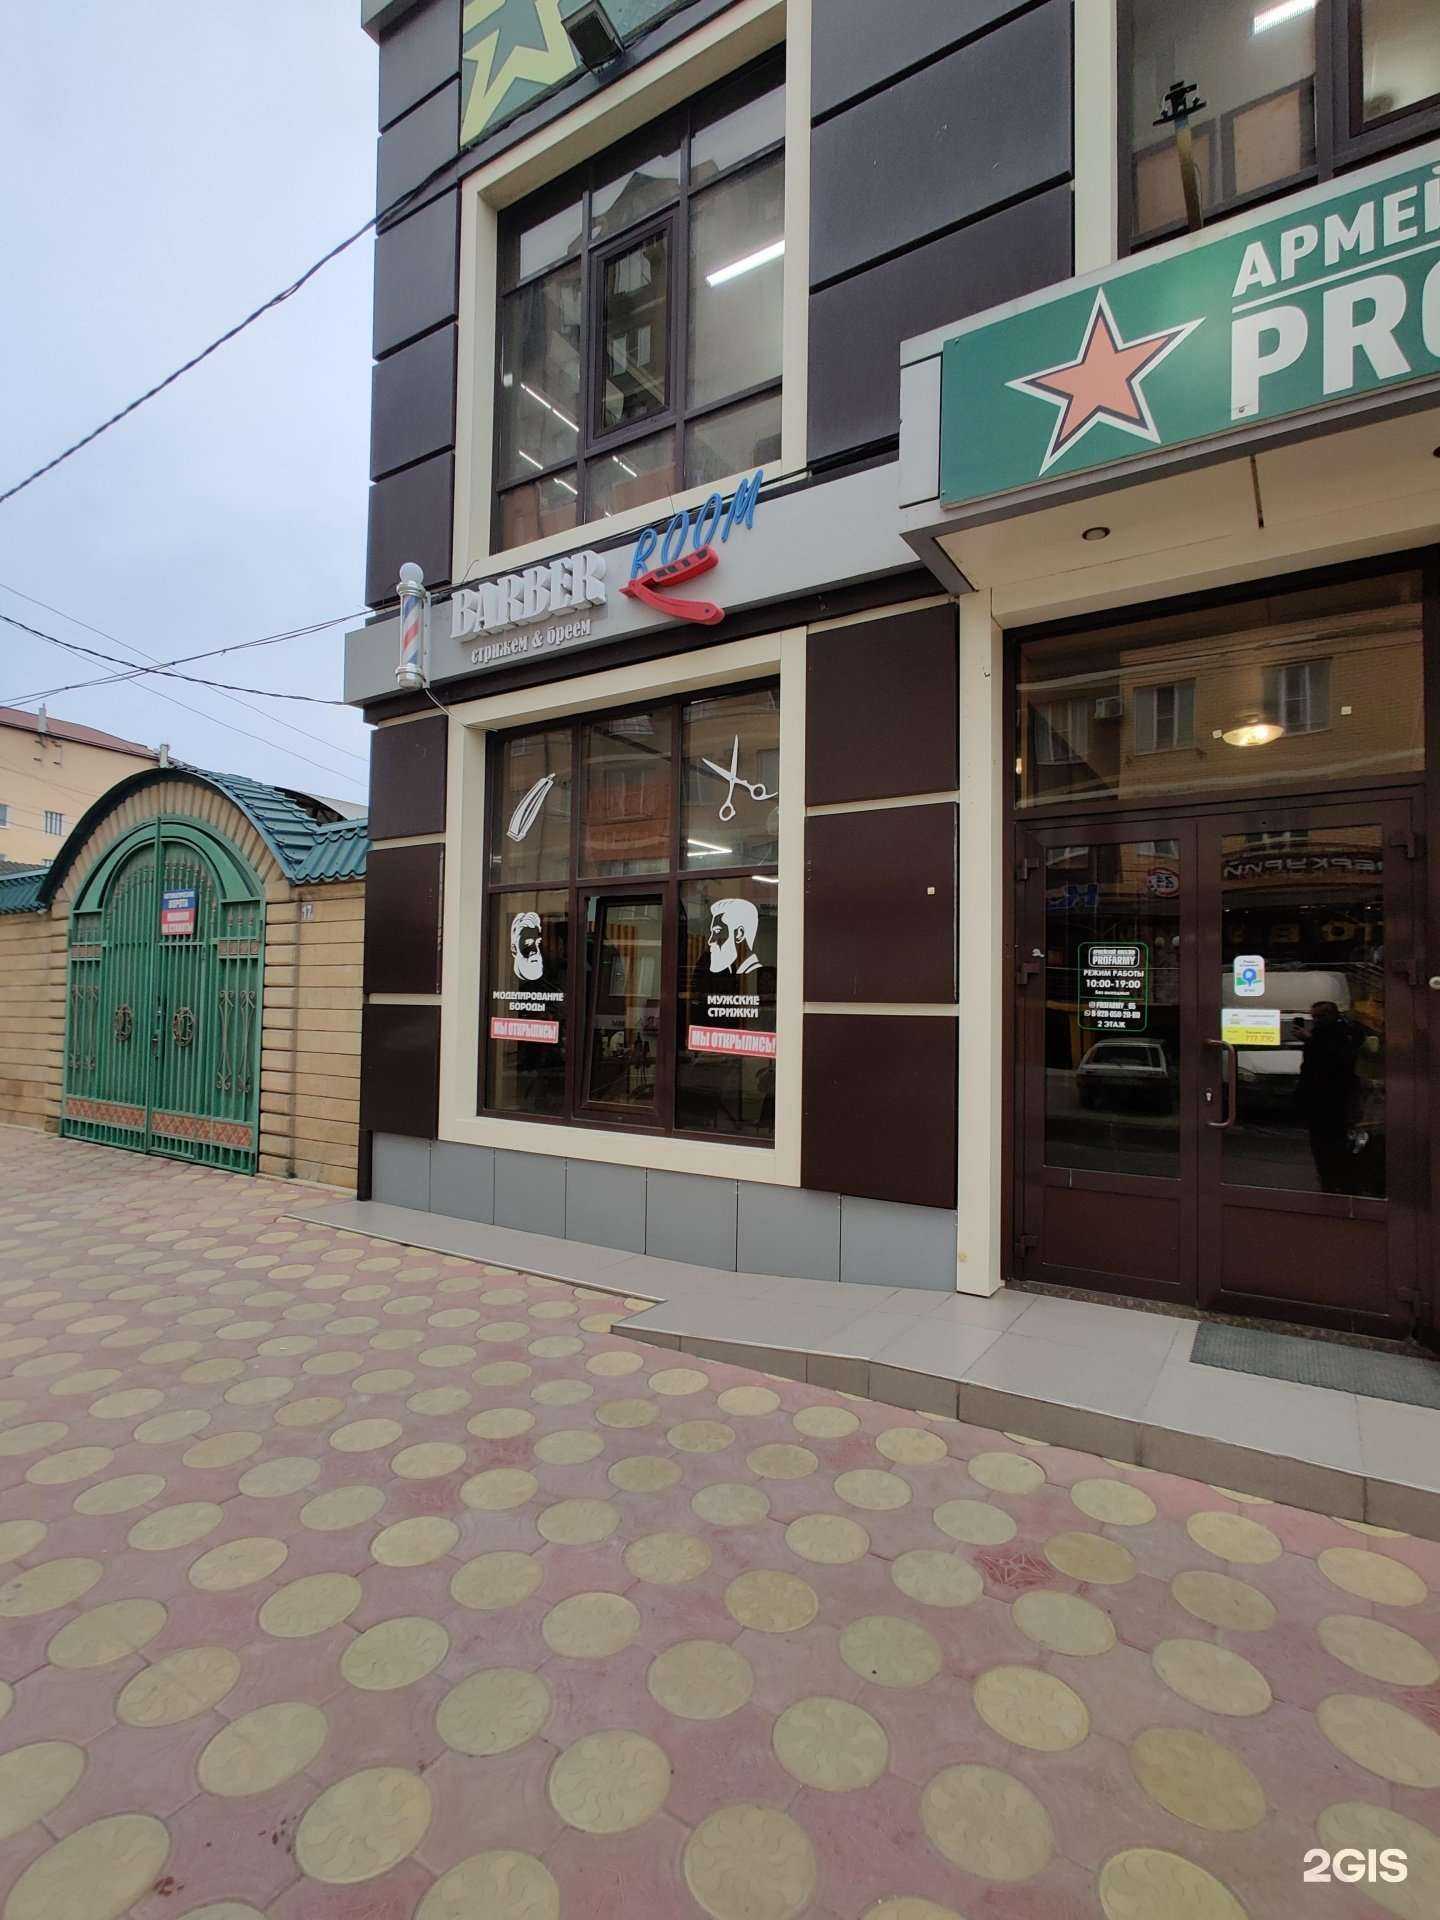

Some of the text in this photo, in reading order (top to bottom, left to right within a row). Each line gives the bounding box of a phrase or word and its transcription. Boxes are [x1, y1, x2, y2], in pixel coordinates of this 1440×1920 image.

[1230, 259, 1440, 421] PR
[630, 469, 764, 580] ROOM
[450, 550, 608, 642] BARBER
[471, 619, 591, 665] стрижем & бреем
[1092, 956, 1136, 965] PROFARMY
[1086, 979, 1140, 988] 10:00-19:00
[492, 990, 564, 1002] МОДЕЛИРОВАНИЕ
[707, 994, 760, 1006] МУЖСКИЕ
[508, 1002, 546, 1012] БОРОДЫ
[707, 1007, 759, 1018] СТРИЖКИ
[1097, 1020, 1126, 1029] 2 ЭТАЖ
[691, 1030, 710, 1047] МЫ
